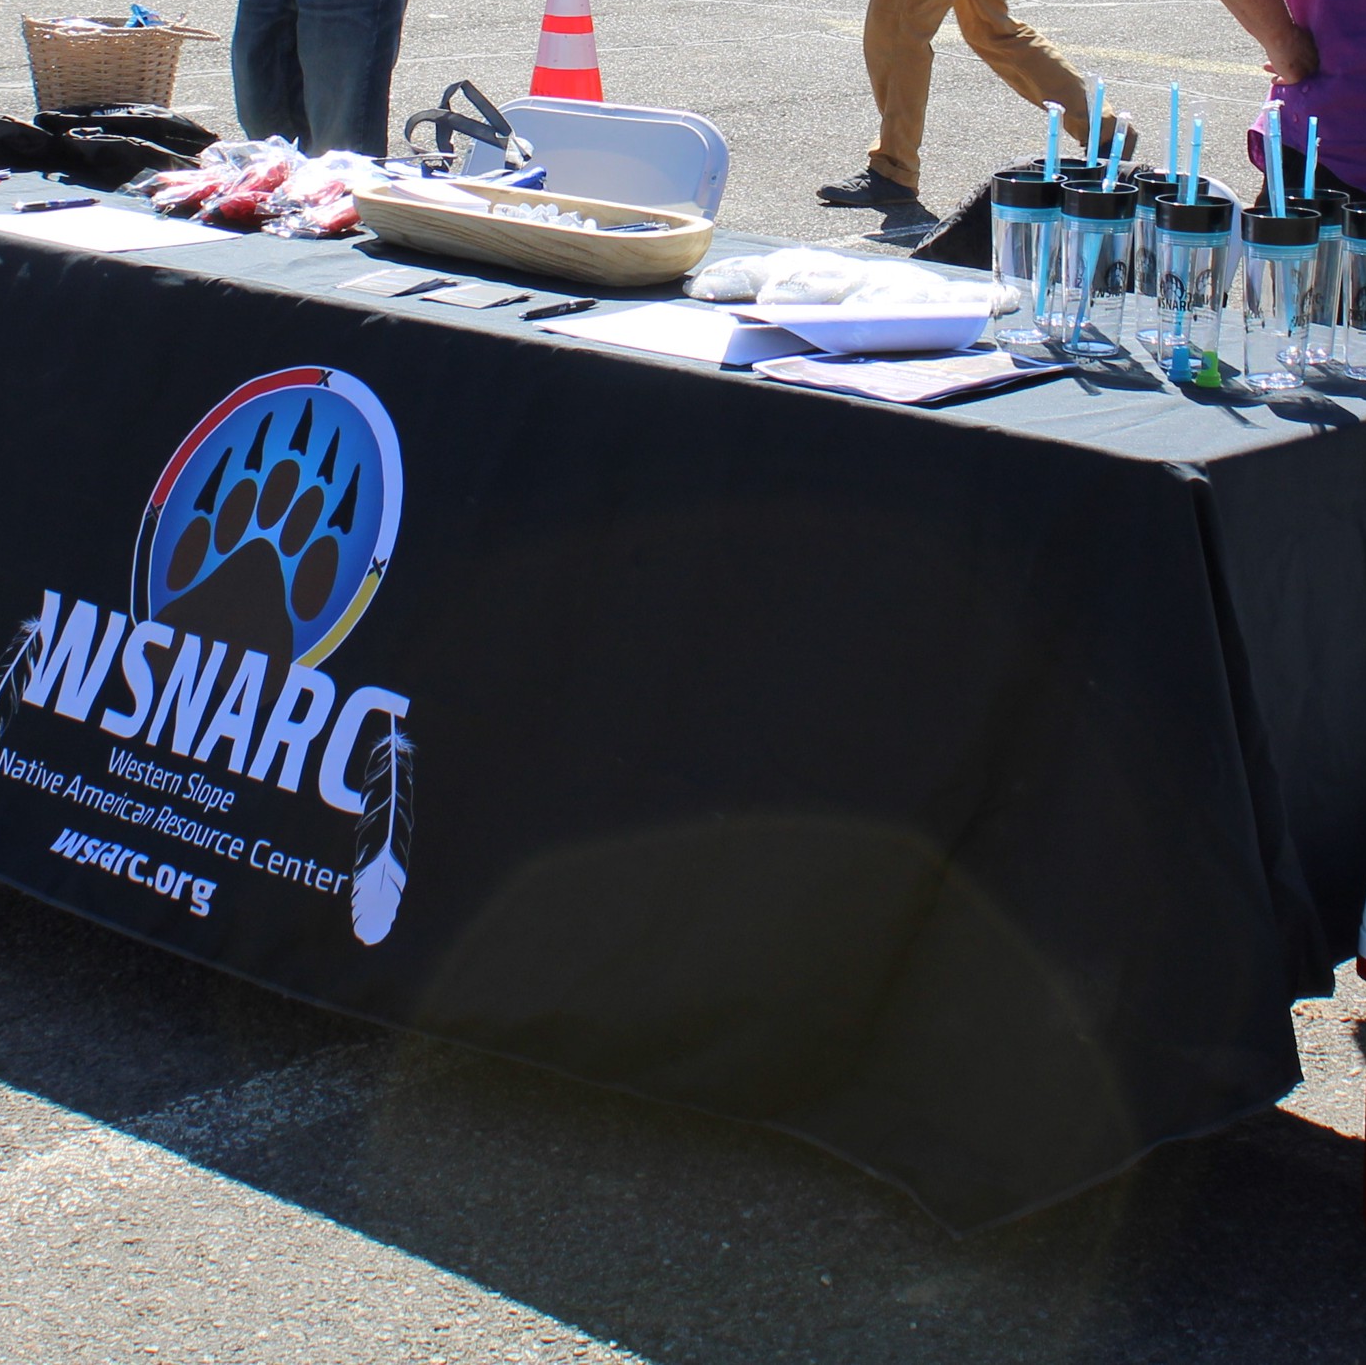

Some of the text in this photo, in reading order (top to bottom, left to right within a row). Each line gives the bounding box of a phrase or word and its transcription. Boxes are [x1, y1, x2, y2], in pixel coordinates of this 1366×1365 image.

[22, 589, 410, 815] WSNARC
[62, 775, 155, 826] American
[152, 805, 244, 861] Resource
[249, 838, 349, 895] Center
[108, 746, 236, 814] Western Slope
